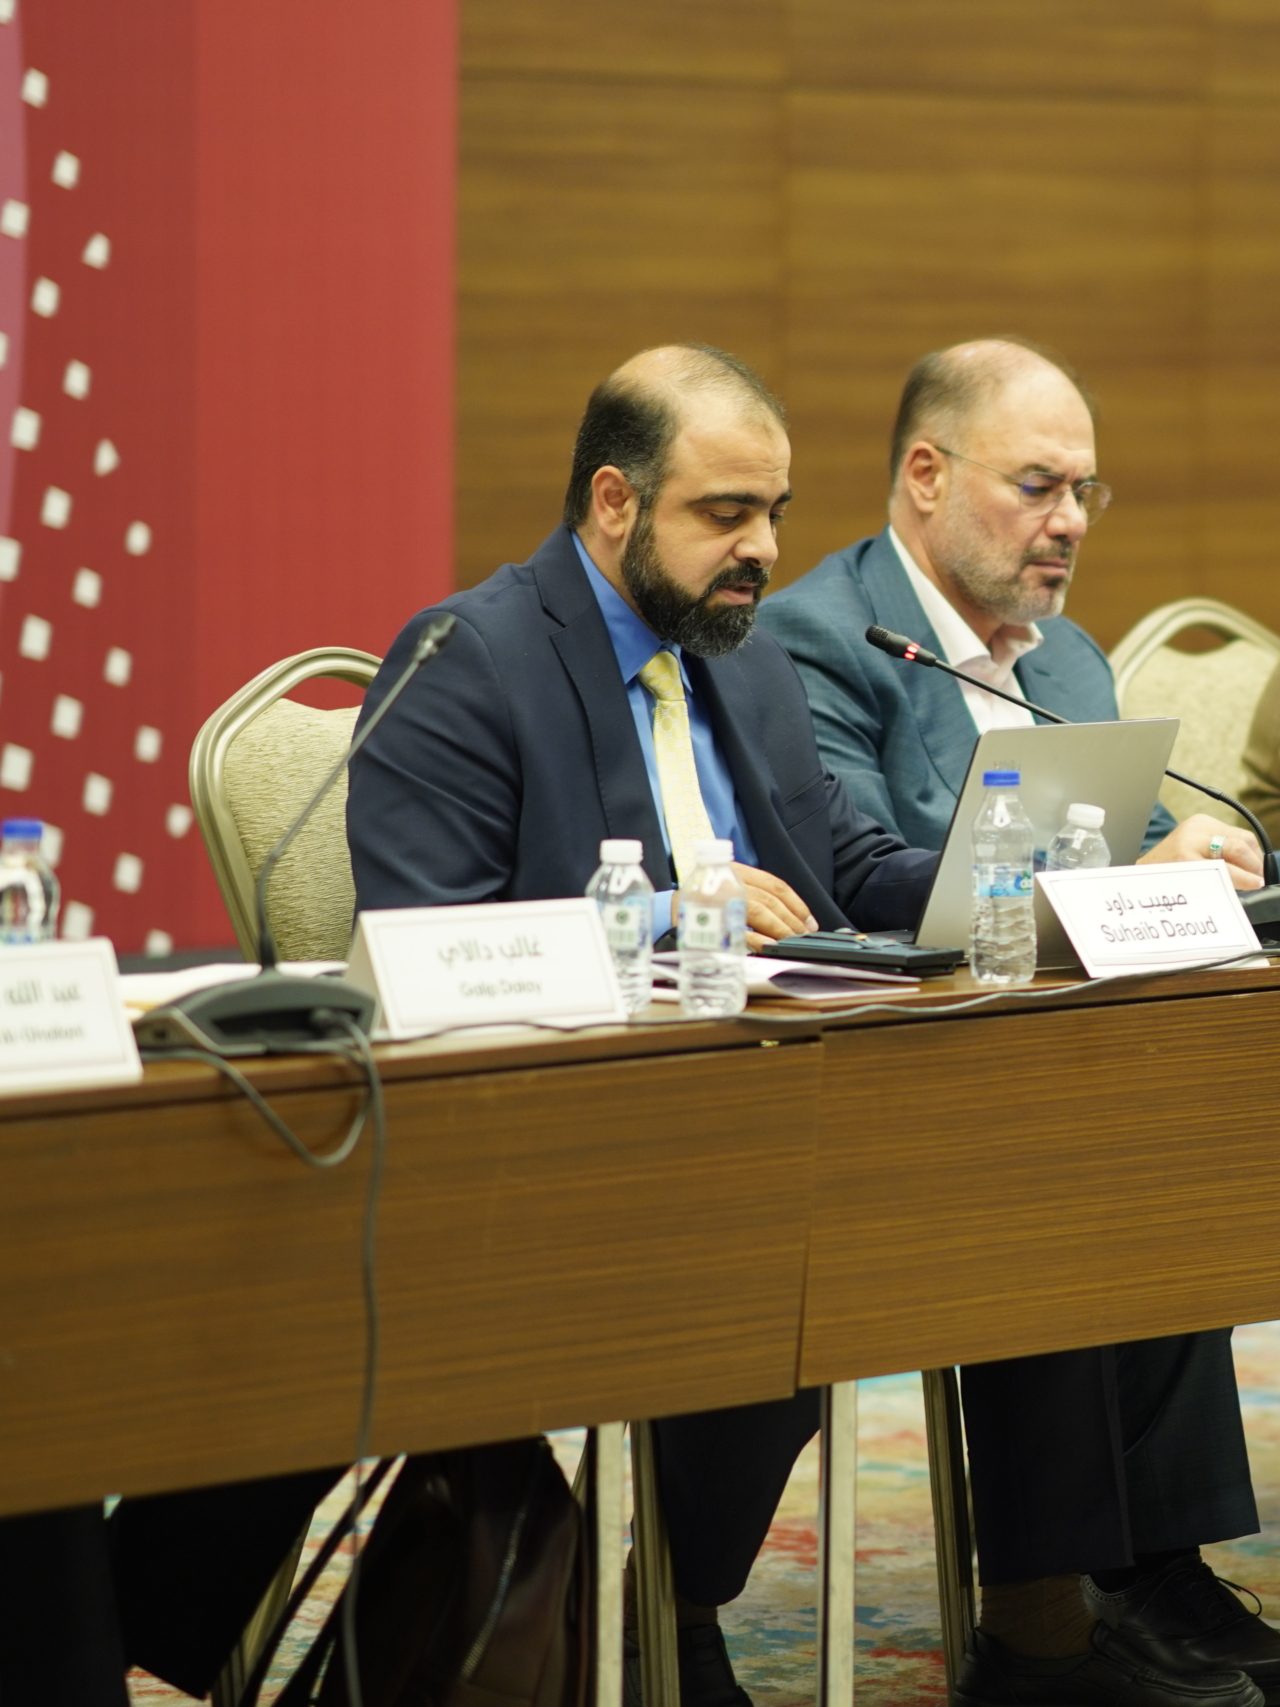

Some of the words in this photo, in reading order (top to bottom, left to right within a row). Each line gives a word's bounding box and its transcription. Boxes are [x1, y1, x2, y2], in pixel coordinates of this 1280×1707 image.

[1105, 892, 1134, 916] داود
[1138, 893, 1188, 914] صهيب
[1101, 921, 1160, 943] Suhaib
[1160, 915, 1219, 938] Daoud
